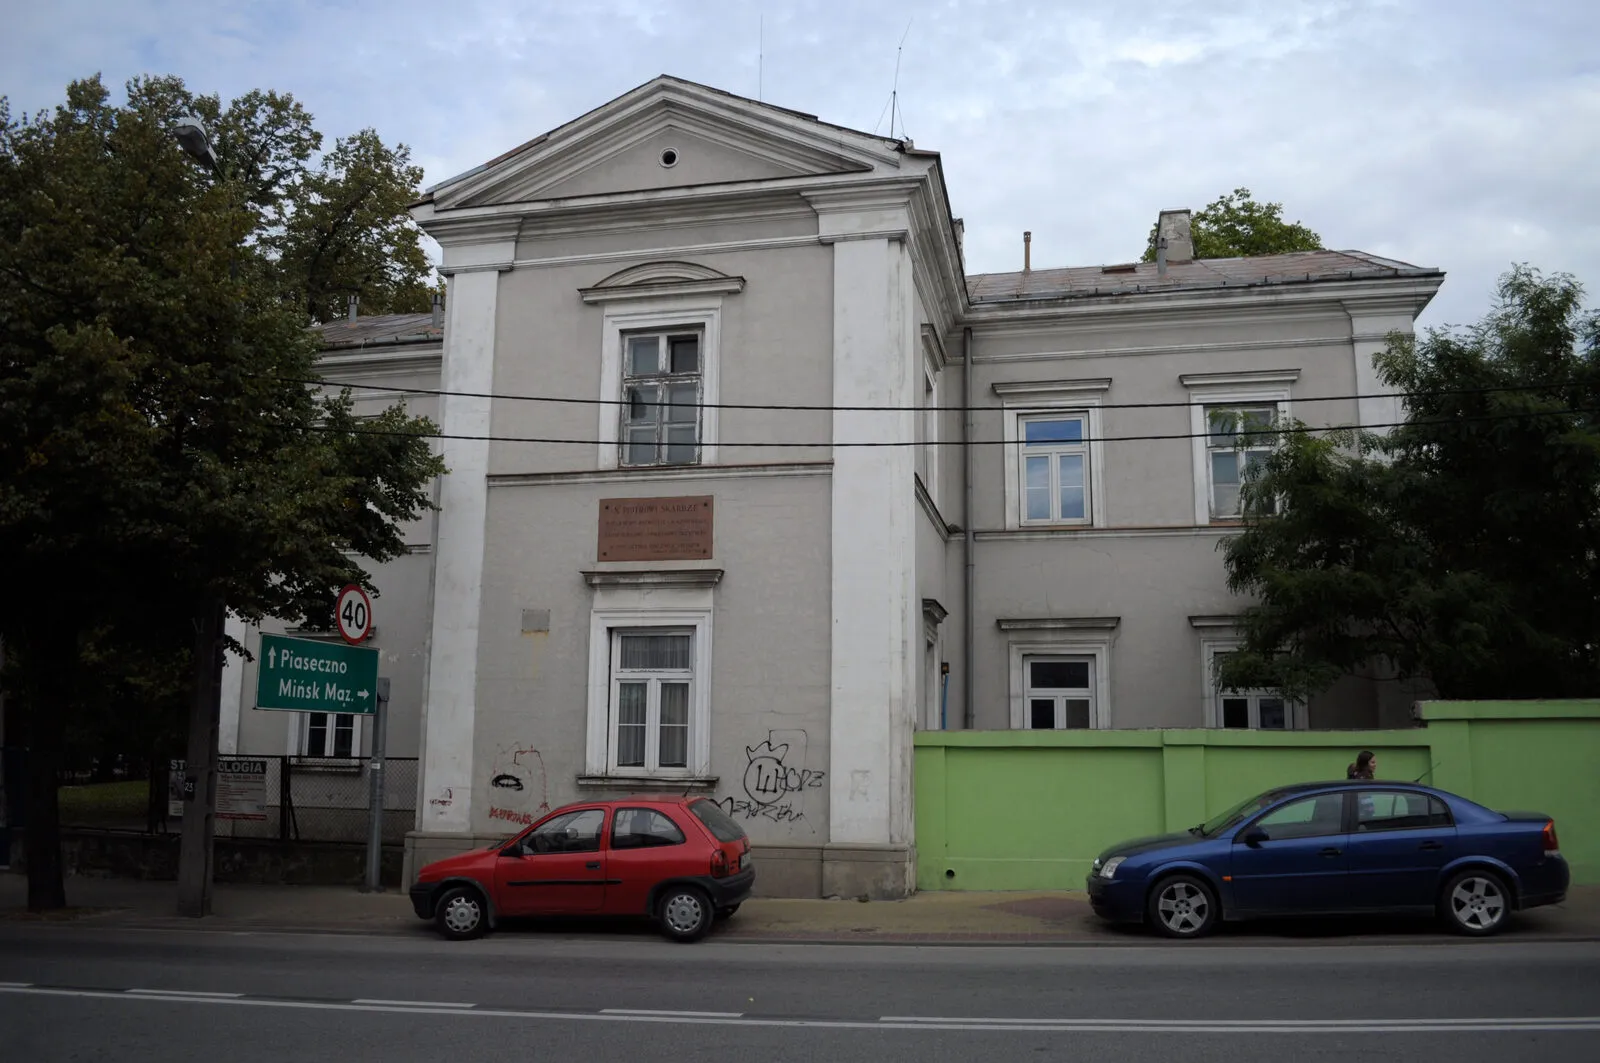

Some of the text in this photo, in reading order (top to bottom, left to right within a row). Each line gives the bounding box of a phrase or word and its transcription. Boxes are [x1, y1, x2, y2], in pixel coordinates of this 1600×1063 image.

[342, 599, 366, 630] 40
[280, 649, 348, 674] Piaseczno
[278, 678, 354, 702] Mińsk Maz.
[184, 782, 194, 793] 23
